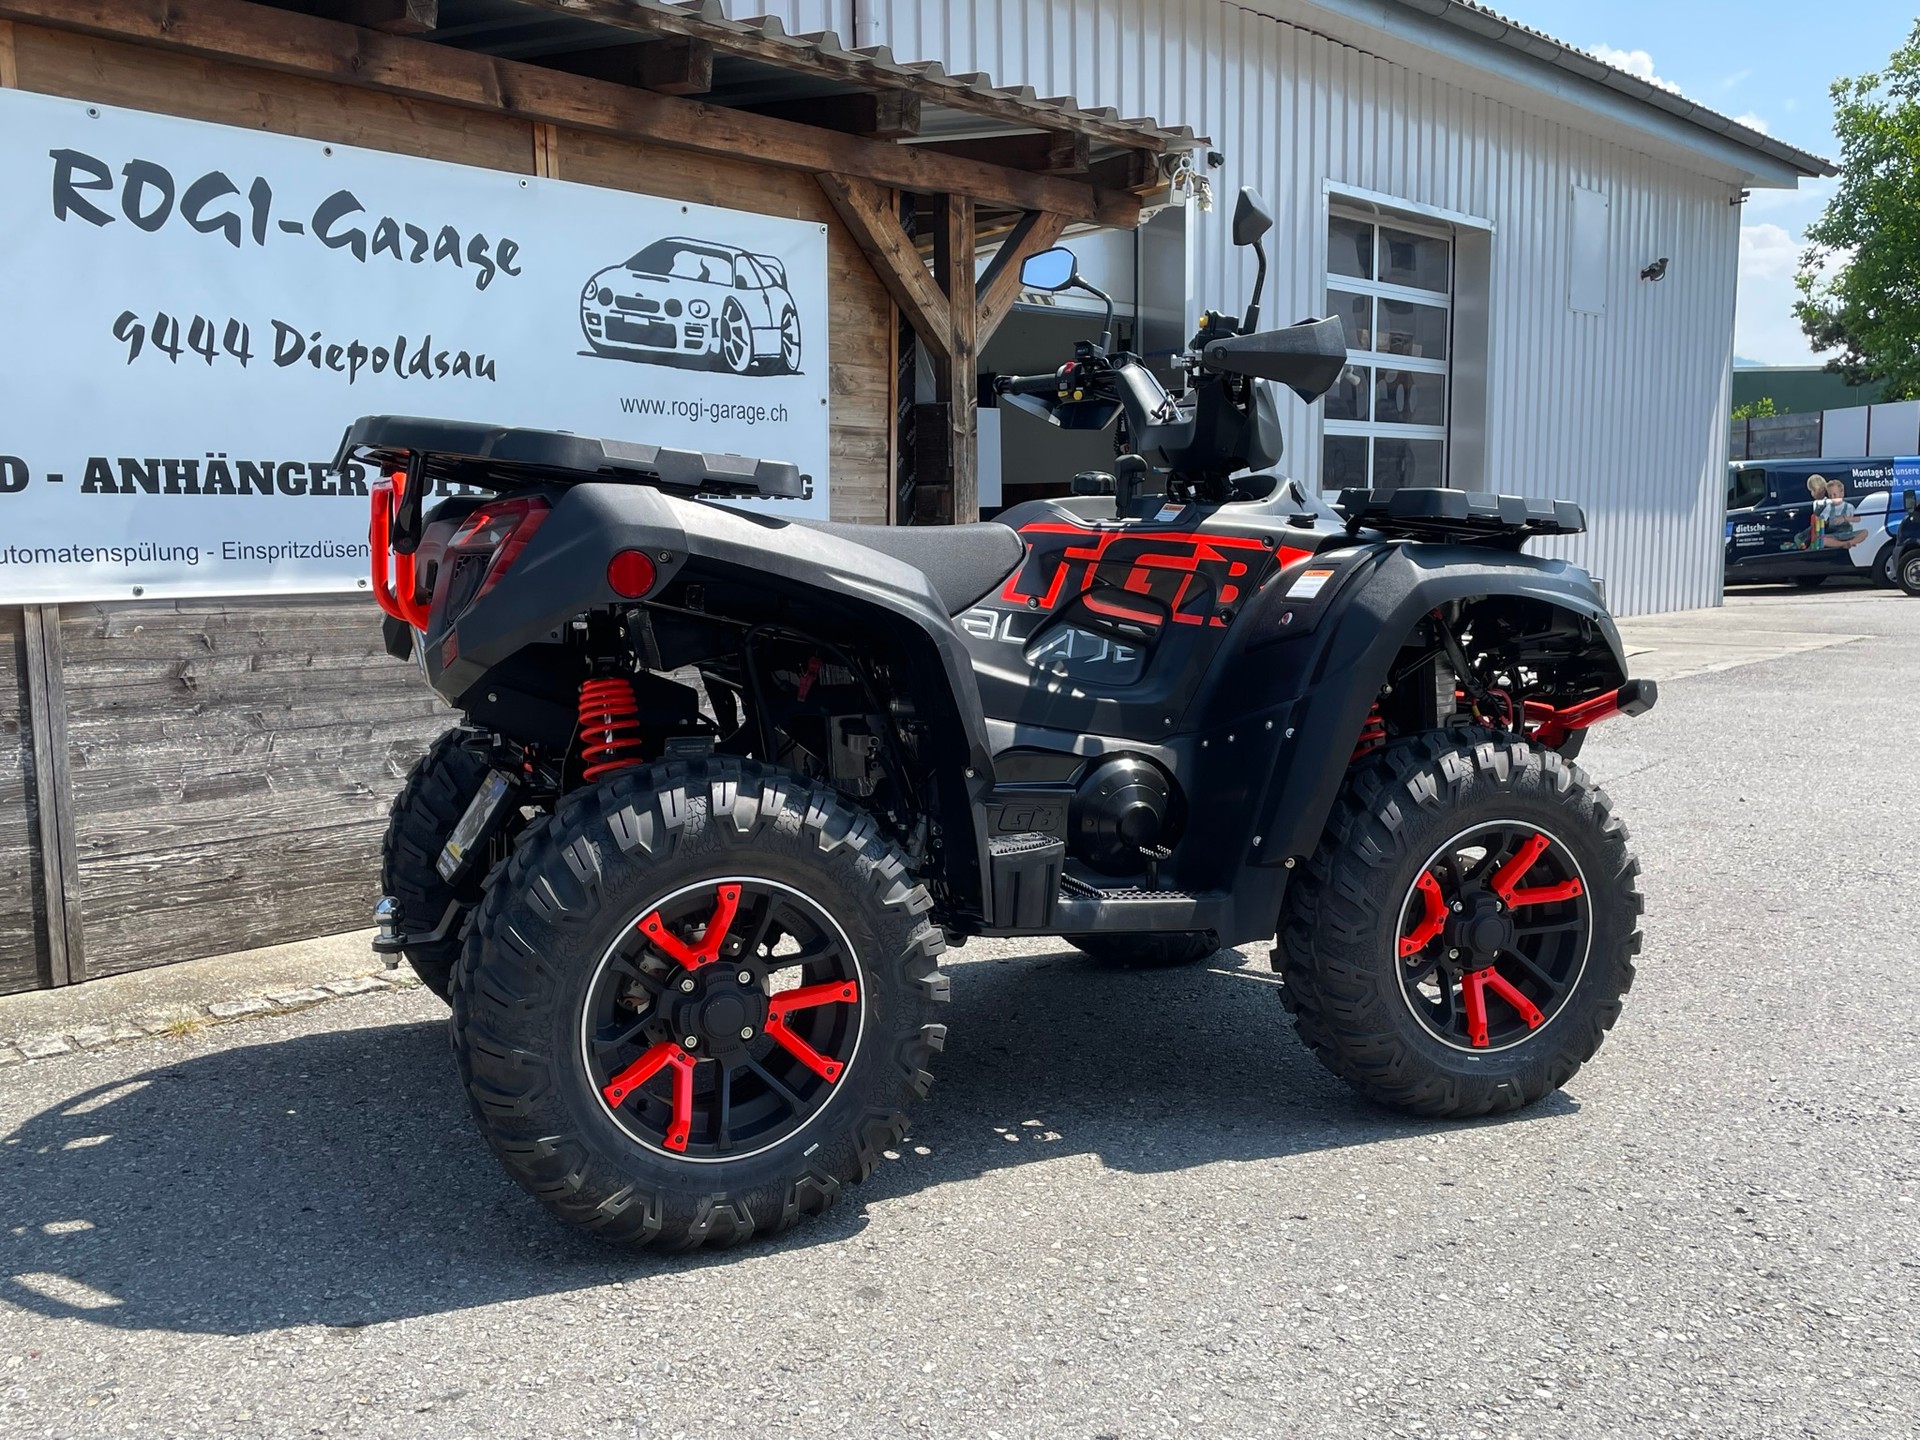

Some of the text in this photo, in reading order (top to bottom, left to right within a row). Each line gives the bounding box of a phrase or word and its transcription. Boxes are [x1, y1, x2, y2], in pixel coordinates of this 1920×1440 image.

[48, 148, 522, 291] ROGI-Garage
[112, 310, 496, 385] 9444 Diepoldsau
[620, 398, 788, 425] www.rogi-garage.ch
[80, 452, 369, 496] ANHÄNGER
[1852, 467, 1920, 478] Montage ist unsere
[1736, 523, 1766, 532] dietsche
